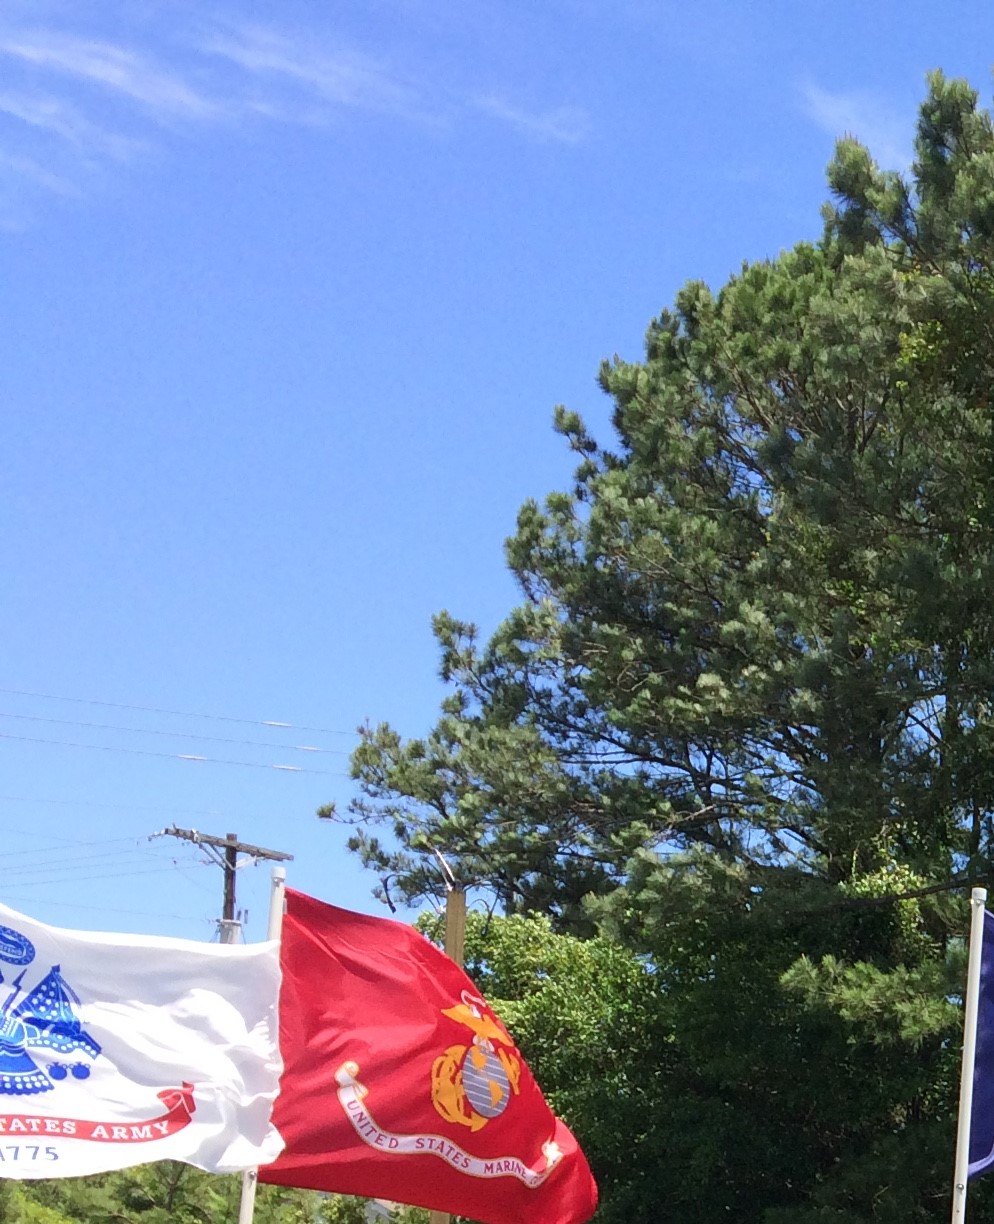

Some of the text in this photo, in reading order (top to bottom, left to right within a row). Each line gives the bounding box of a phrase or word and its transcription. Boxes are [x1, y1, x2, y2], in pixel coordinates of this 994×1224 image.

[0, 1118, 169, 1140] TATES ARMY
[346, 1100, 528, 1178] UNITED STATES MARINE
